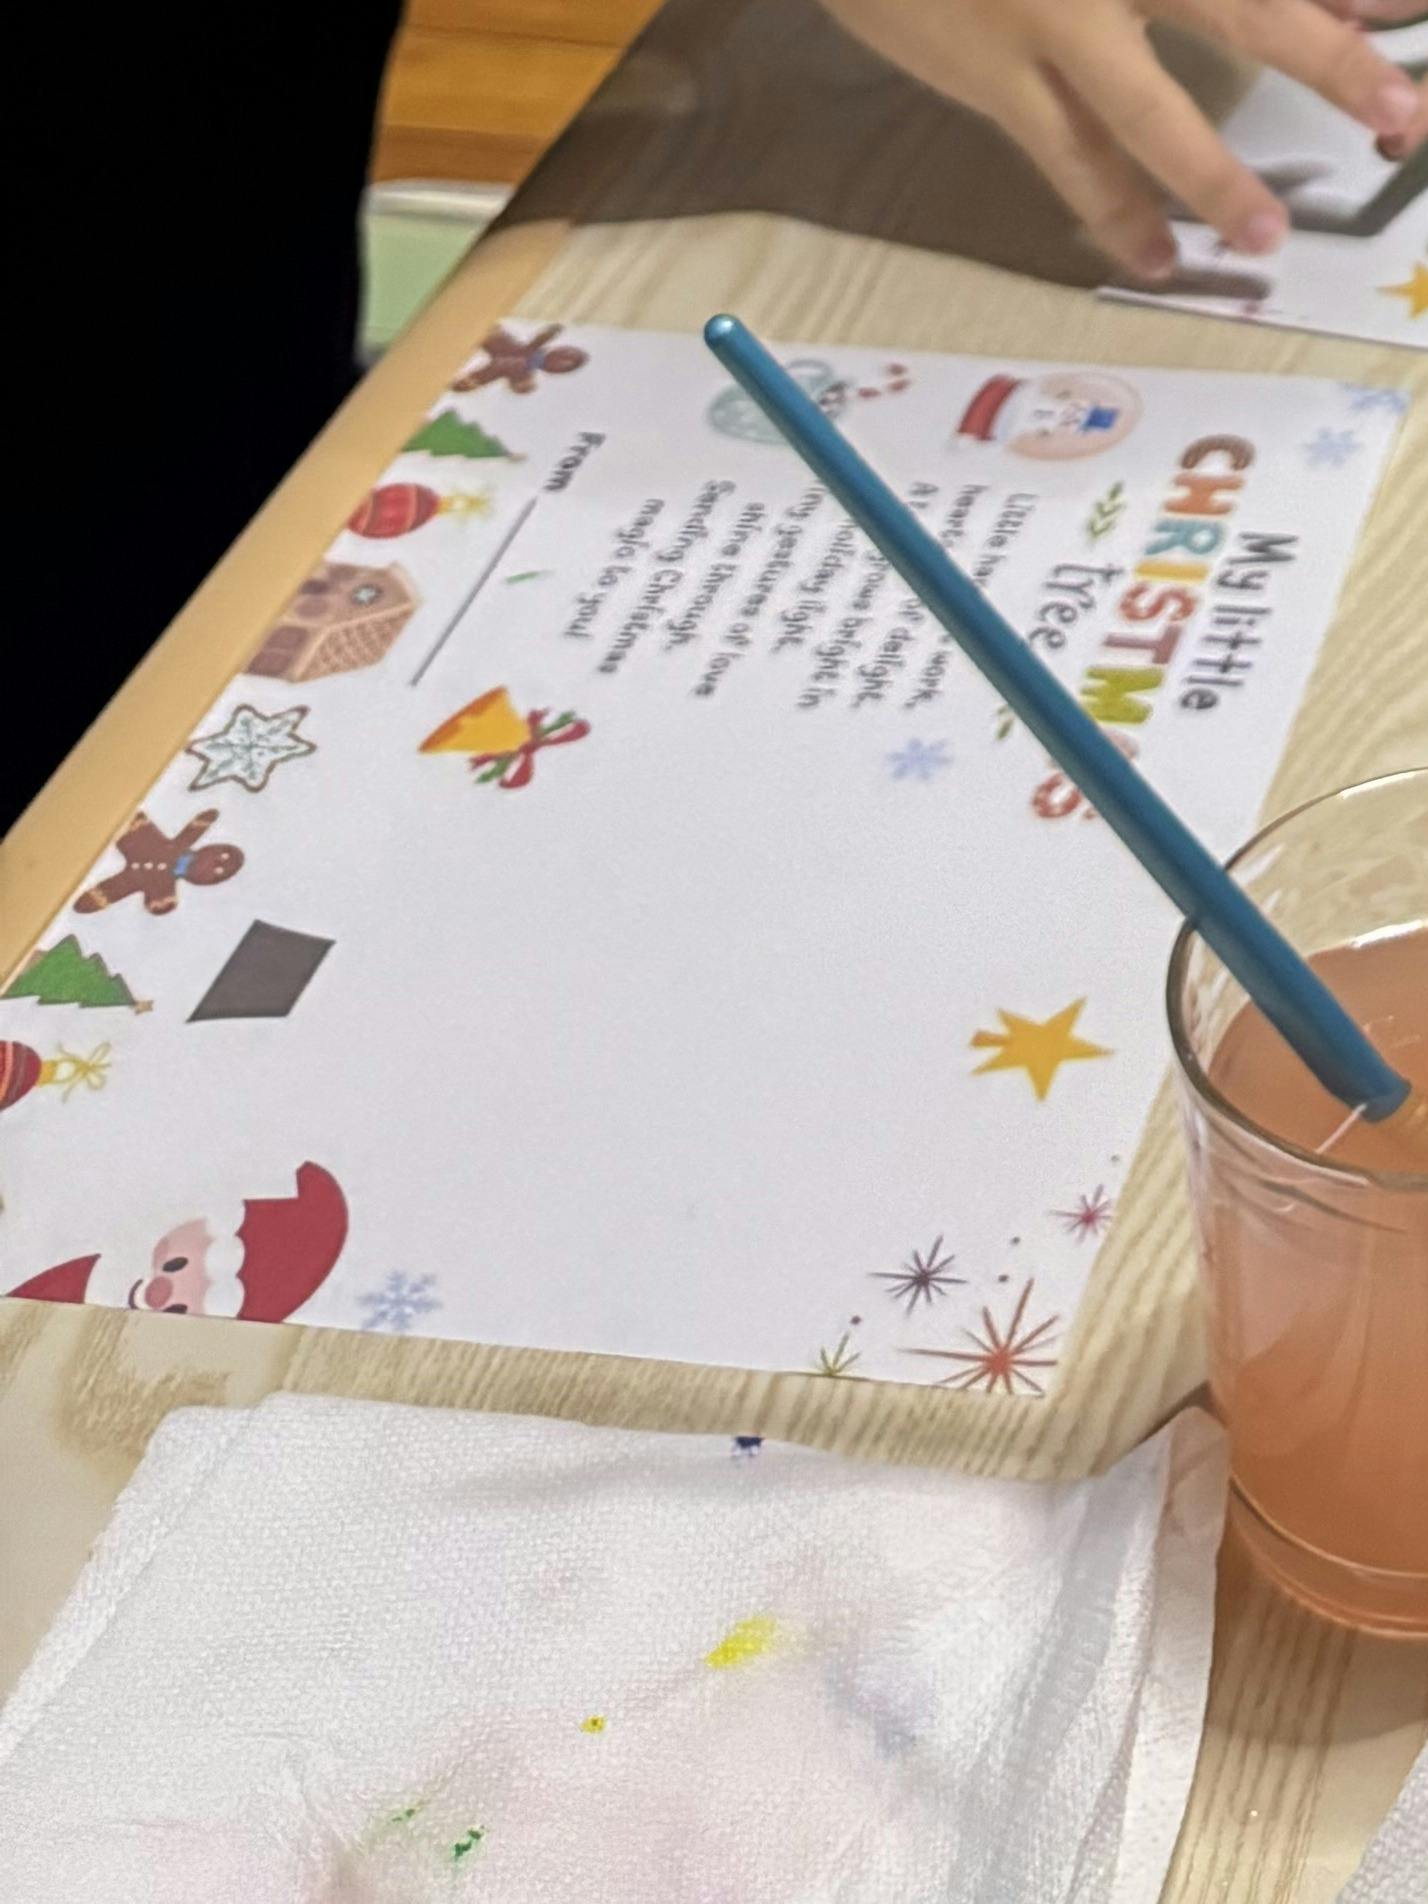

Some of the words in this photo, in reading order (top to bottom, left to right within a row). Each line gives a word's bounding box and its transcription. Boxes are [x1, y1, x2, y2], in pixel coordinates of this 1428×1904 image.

[544, 432, 607, 492] From
[616, 499, 666, 557] magic
[655, 481, 737, 562] Sending
[721, 502, 766, 556] shine
[989, 493, 1040, 548] Little
[598, 566, 633, 586] to
[740, 524, 804, 617] gestures
[1216, 532, 1298, 591] My
[598, 570, 684, 674] Christmas
[726, 623, 753, 646] of
[1029, 563, 1125, 649] tree
[695, 652, 748, 697] love
[813, 617, 876, 681] bright
[1179, 605, 1272, 710] little
[799, 688, 838, 709] in
